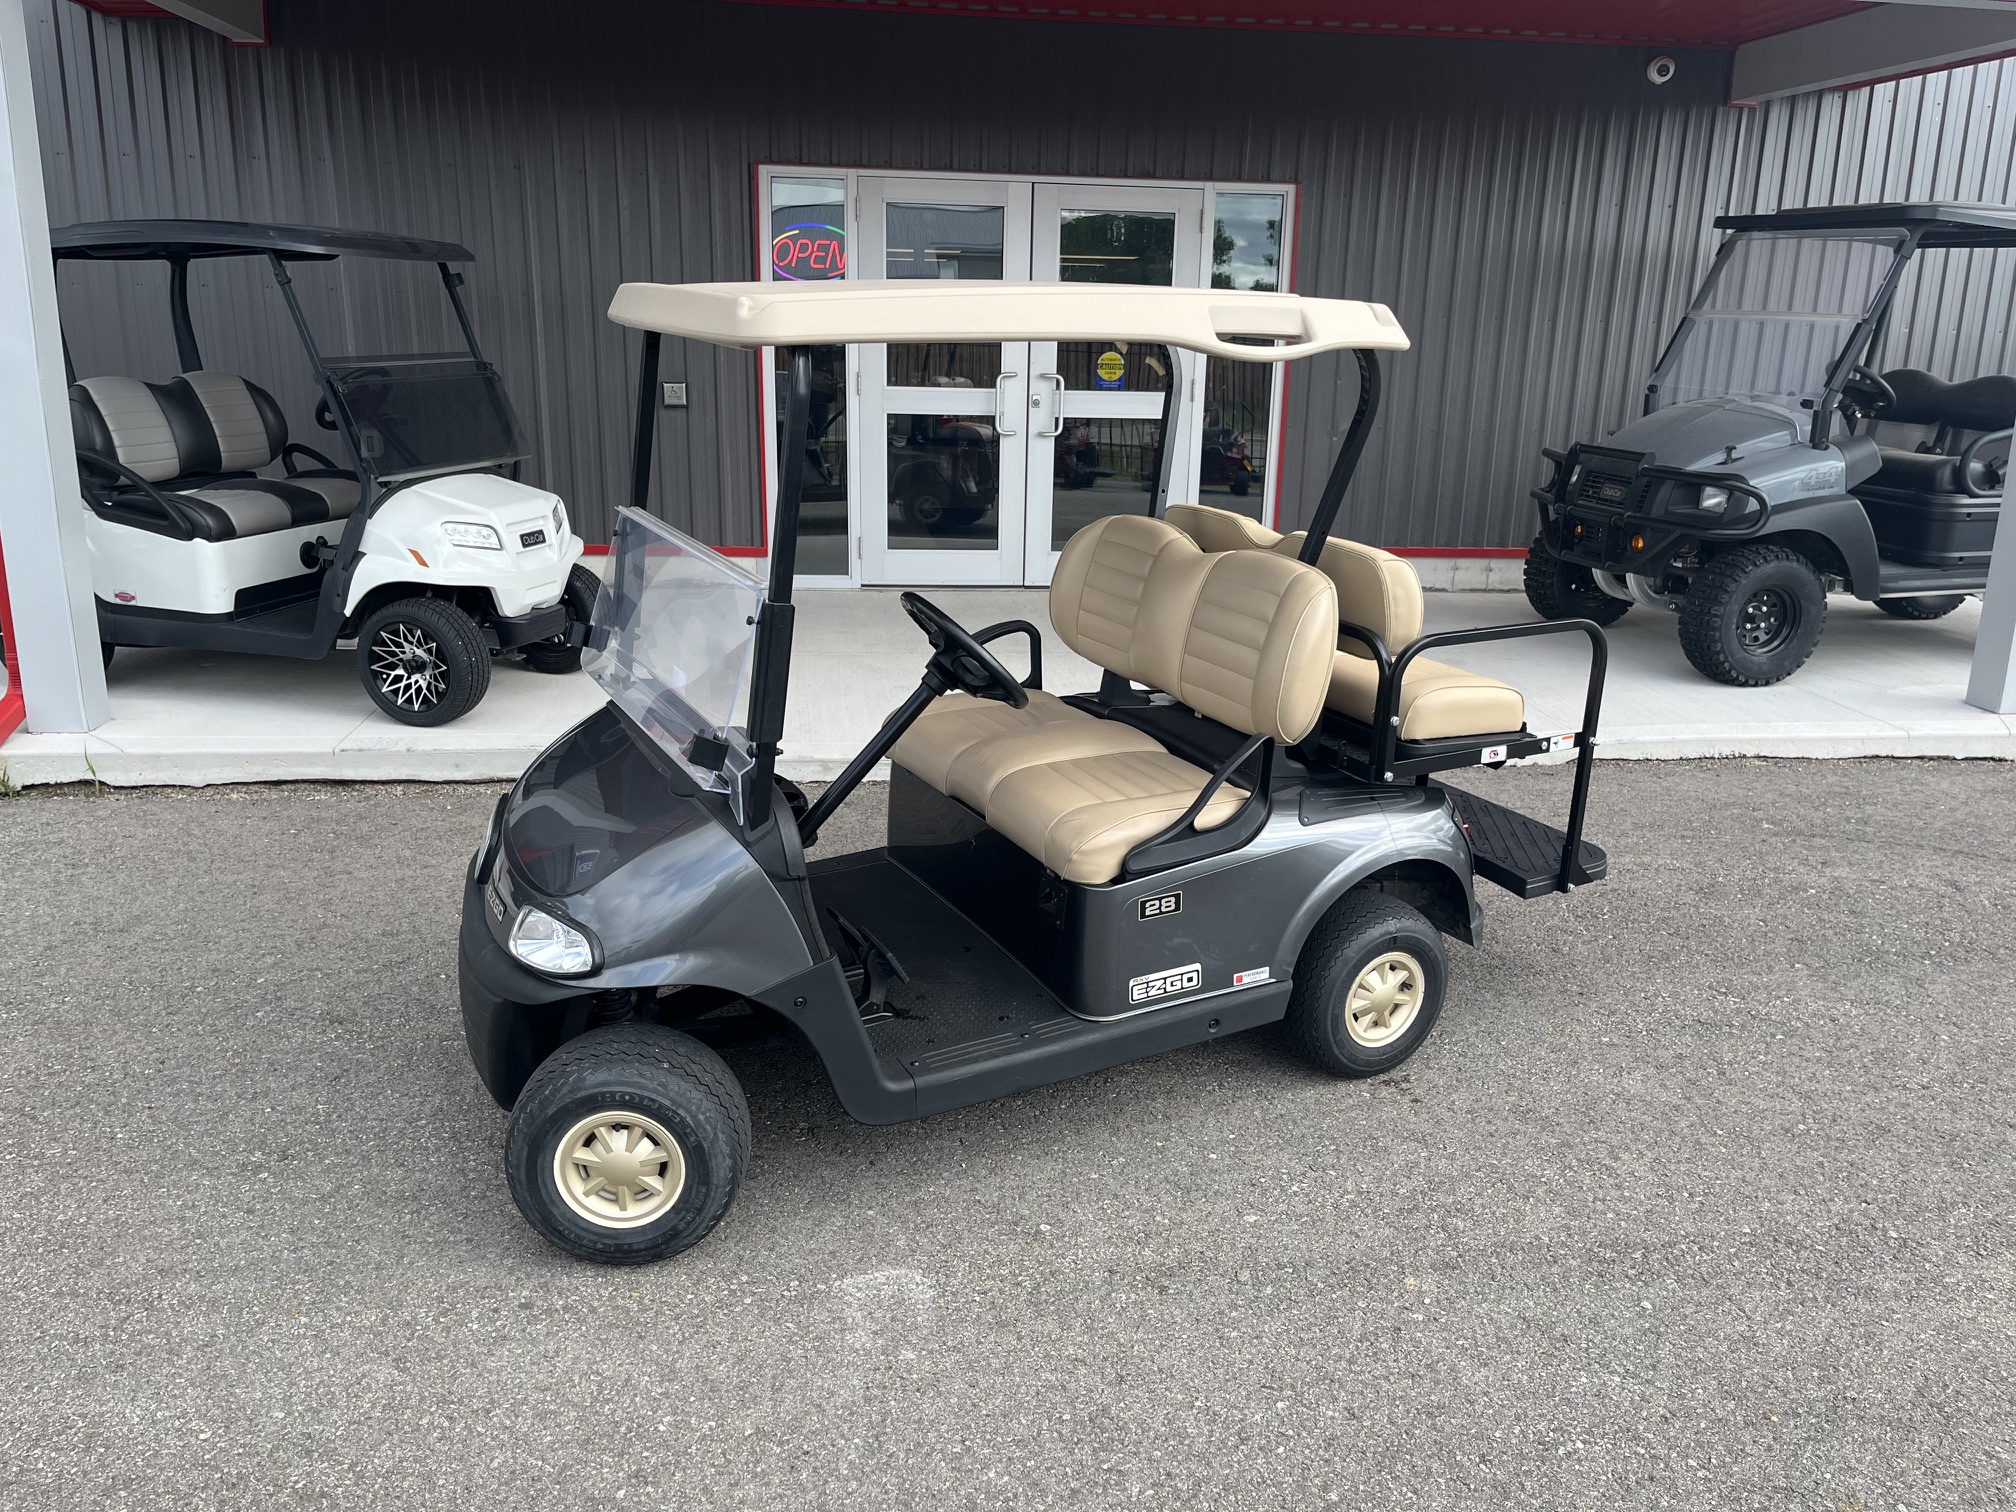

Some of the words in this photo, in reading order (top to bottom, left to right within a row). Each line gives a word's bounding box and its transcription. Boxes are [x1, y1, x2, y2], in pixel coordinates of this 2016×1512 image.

[774, 238, 846, 268] OPEN
[1145, 896, 1176, 916] 28
[1132, 976, 1150, 984] RXV
